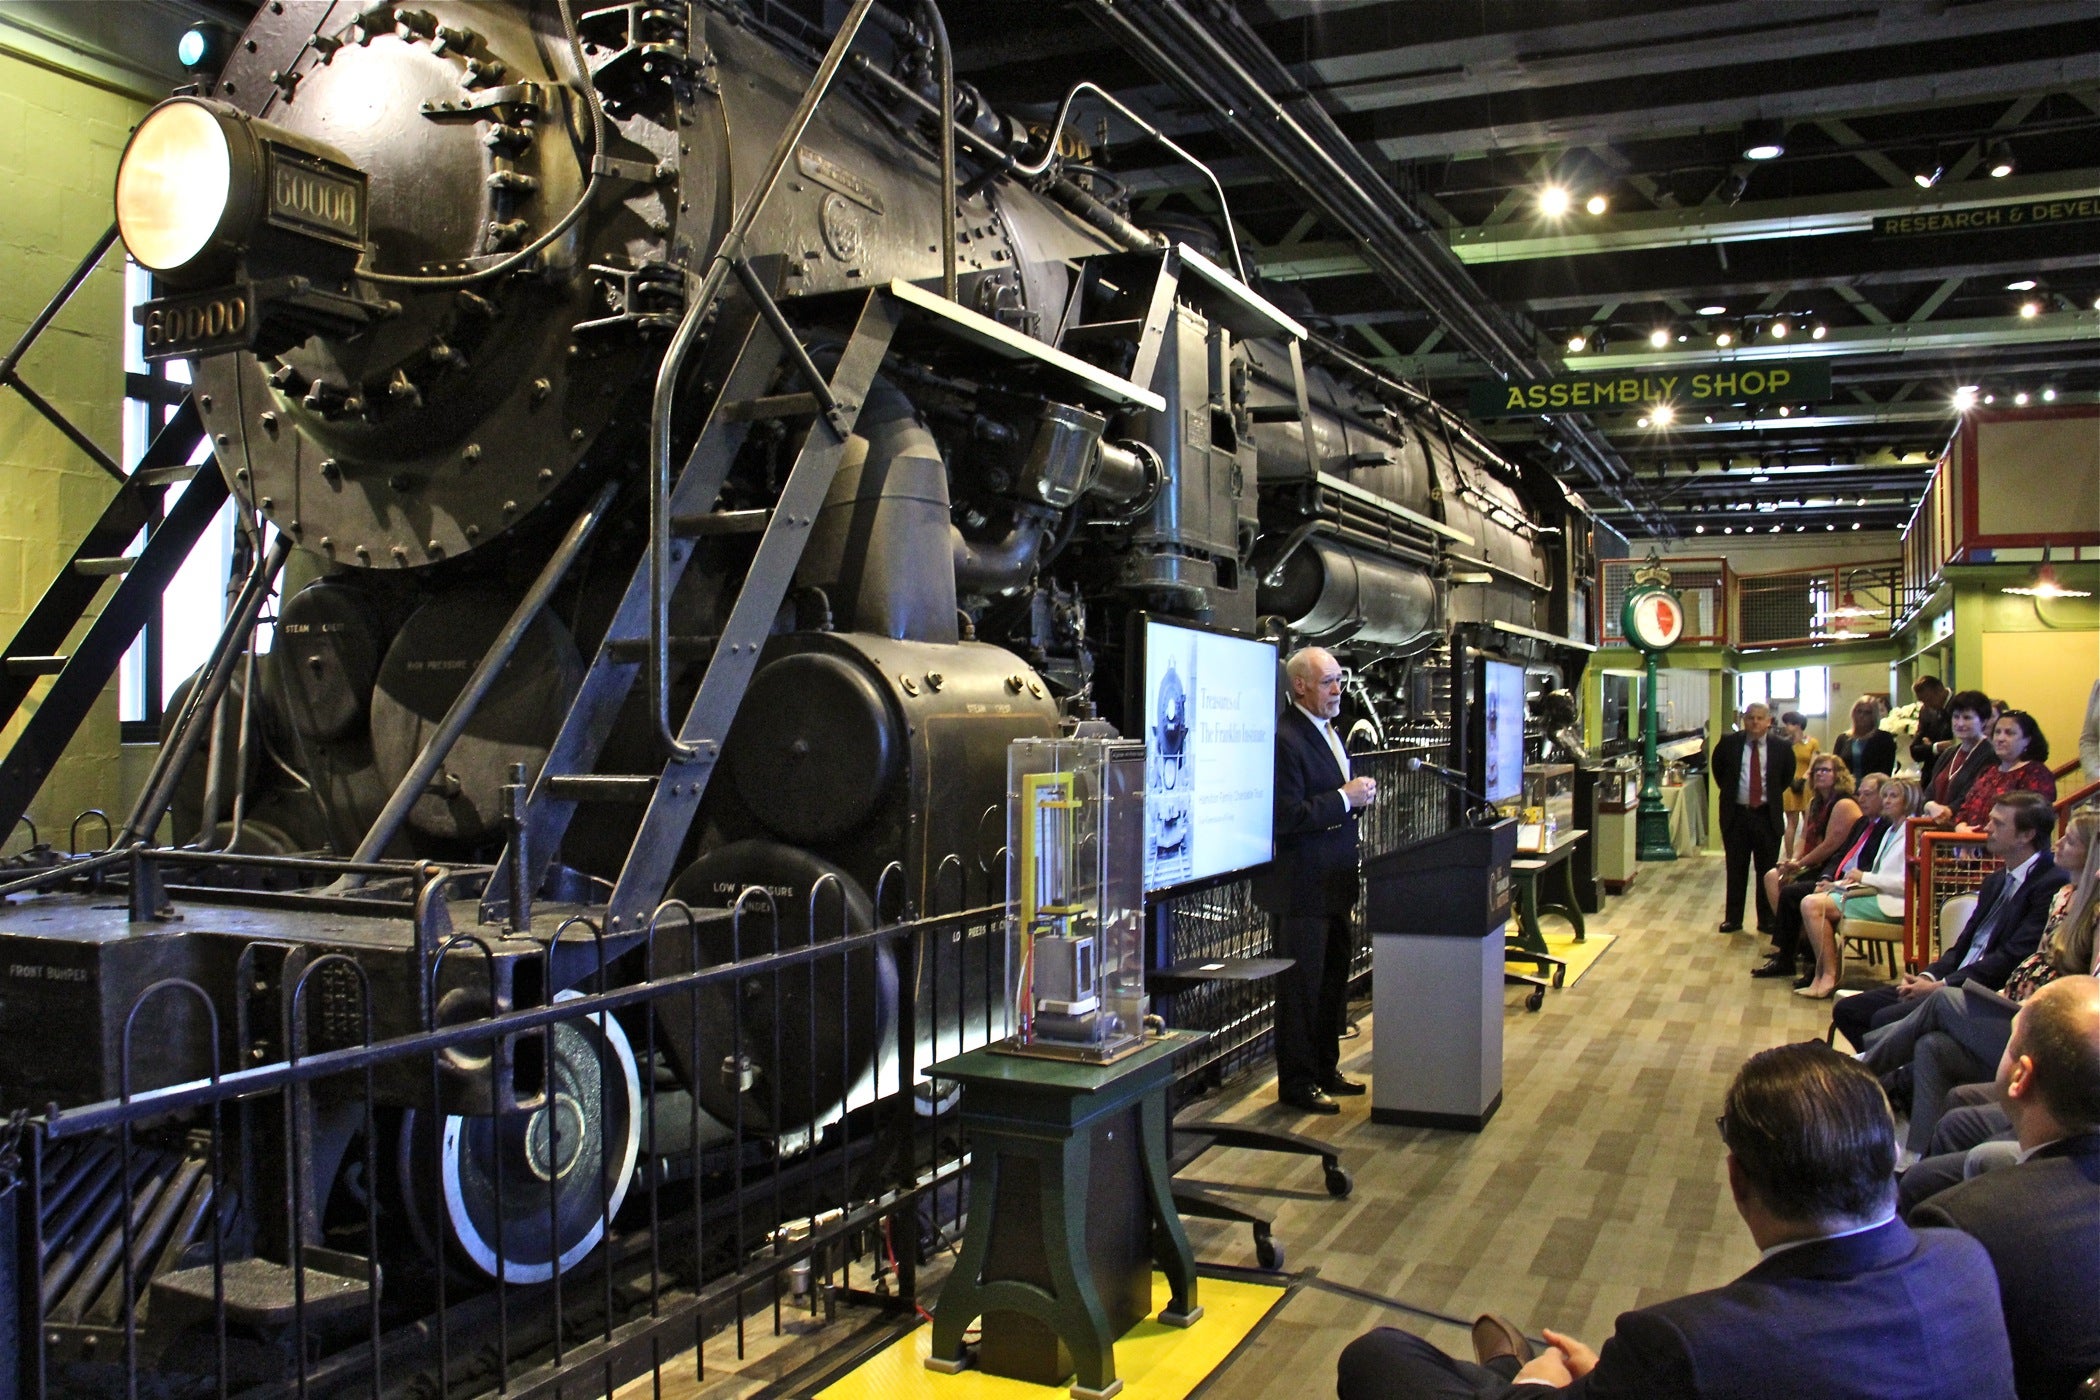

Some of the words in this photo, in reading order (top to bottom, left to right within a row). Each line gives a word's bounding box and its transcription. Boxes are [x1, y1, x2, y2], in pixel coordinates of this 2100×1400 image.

[276, 169, 356, 227] 60000
[1884, 209, 2001, 235] RESEARCH
[2009, 207, 2024, 223] &
[145, 297, 246, 347] 60000
[1505, 376, 1679, 409] ASSEMBLY
[1692, 369, 1791, 399] SHOP
[285, 624, 310, 633] STEAM
[713, 882, 735, 893] LOW
[10, 964, 43, 978] FRONT
[47, 966, 87, 982] BUMPER
